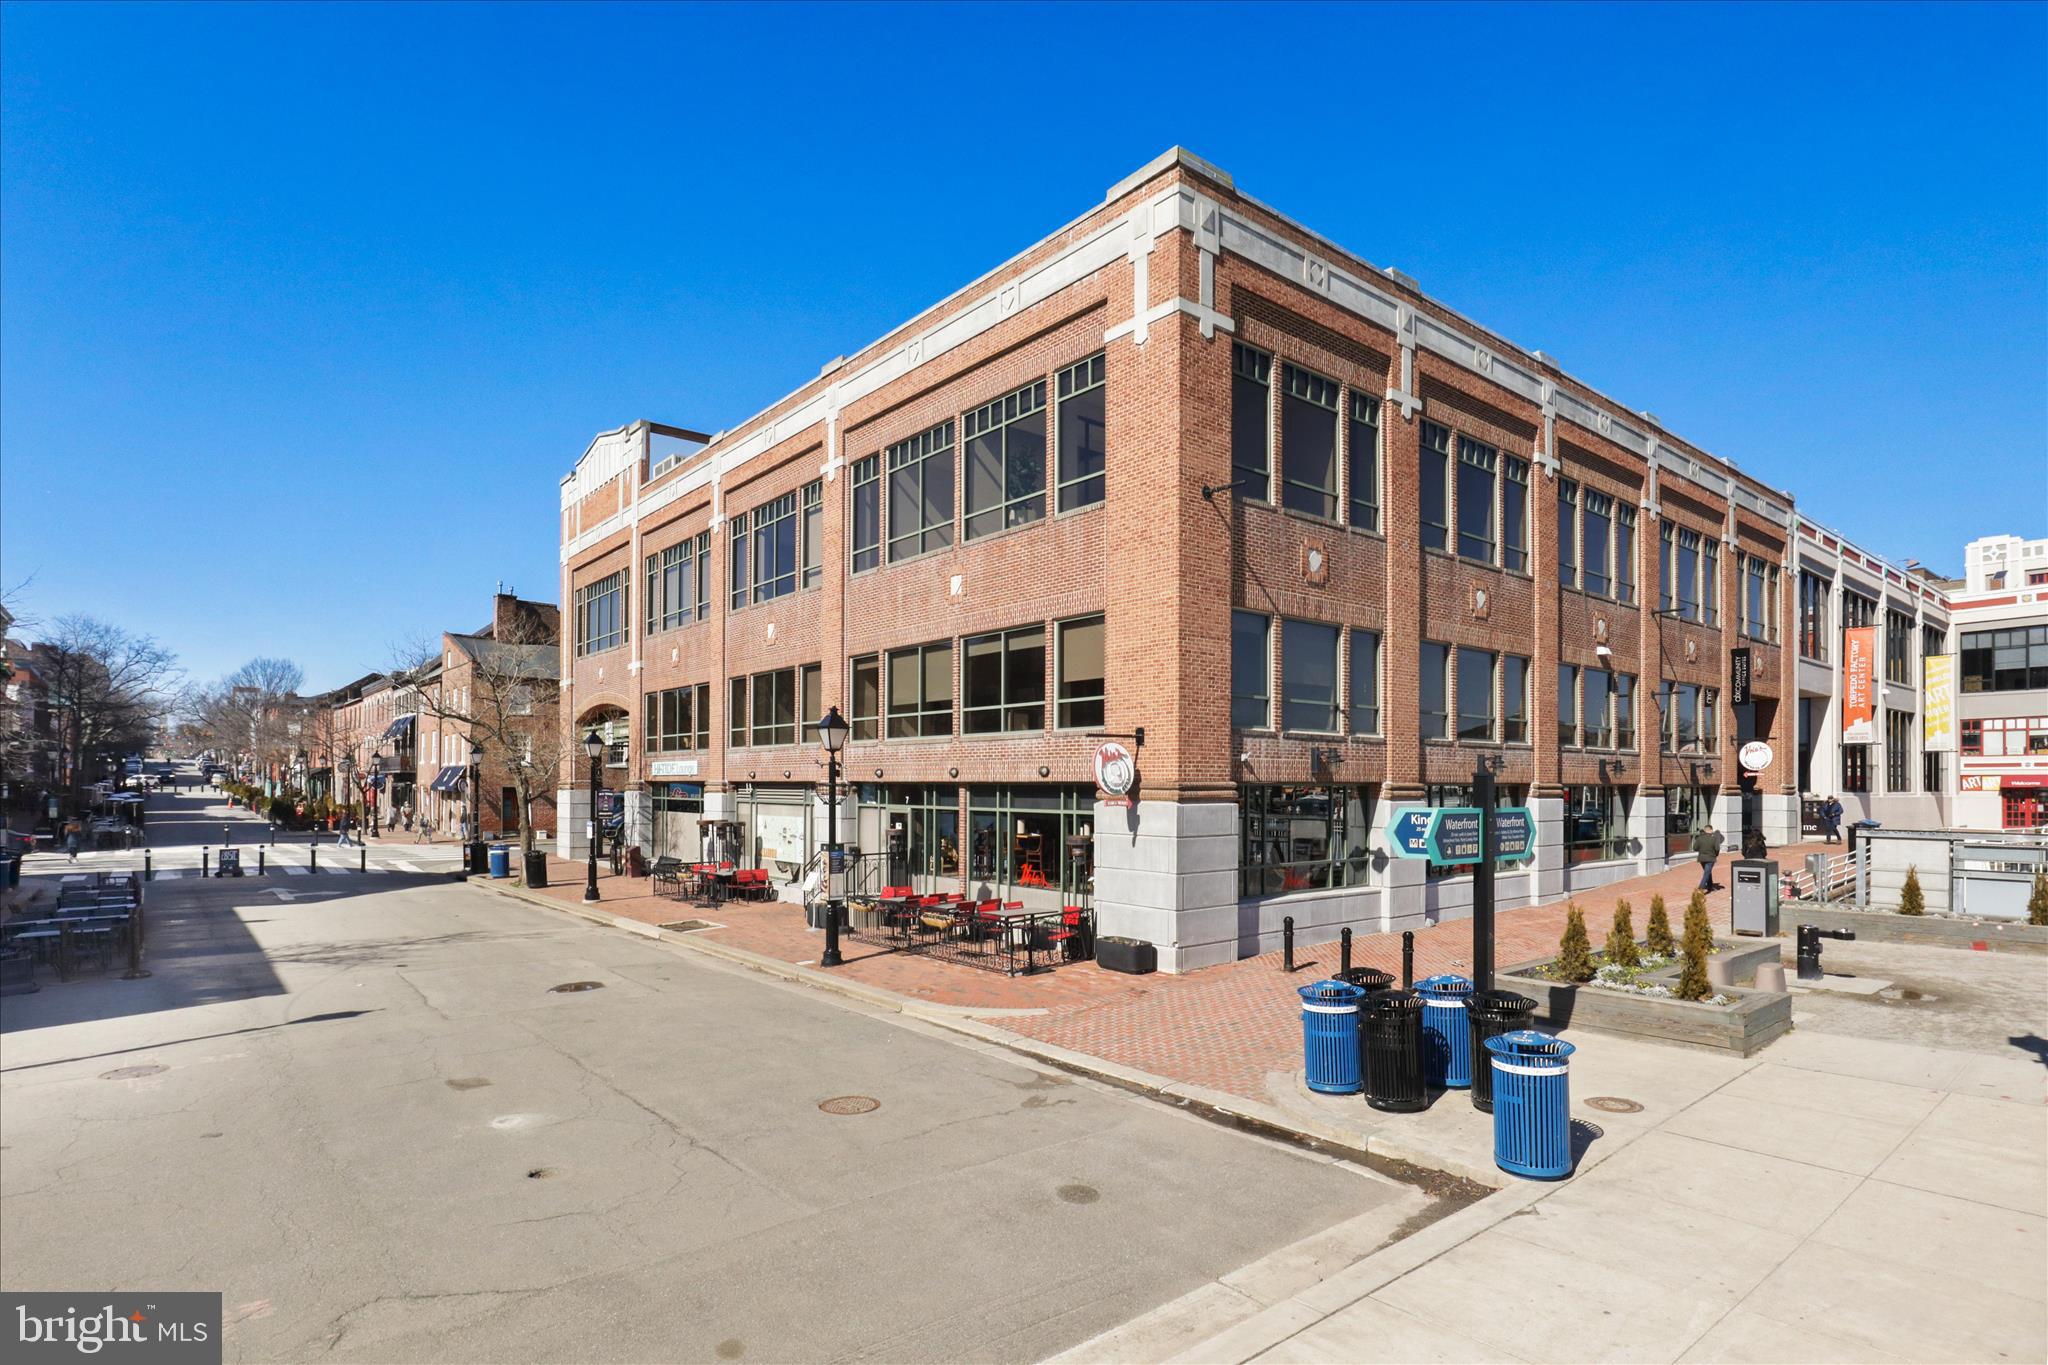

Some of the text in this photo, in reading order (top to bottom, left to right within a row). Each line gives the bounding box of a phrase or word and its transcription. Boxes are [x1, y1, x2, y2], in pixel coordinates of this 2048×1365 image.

[1849, 639, 1860, 708] TORPEDO FACTORY
[1858, 656, 1867, 708] ART CENTER
[1961, 775, 1982, 791] ART
[1445, 817, 1479, 831] Waterfront
[1496, 816, 1525, 828] Waterfront
